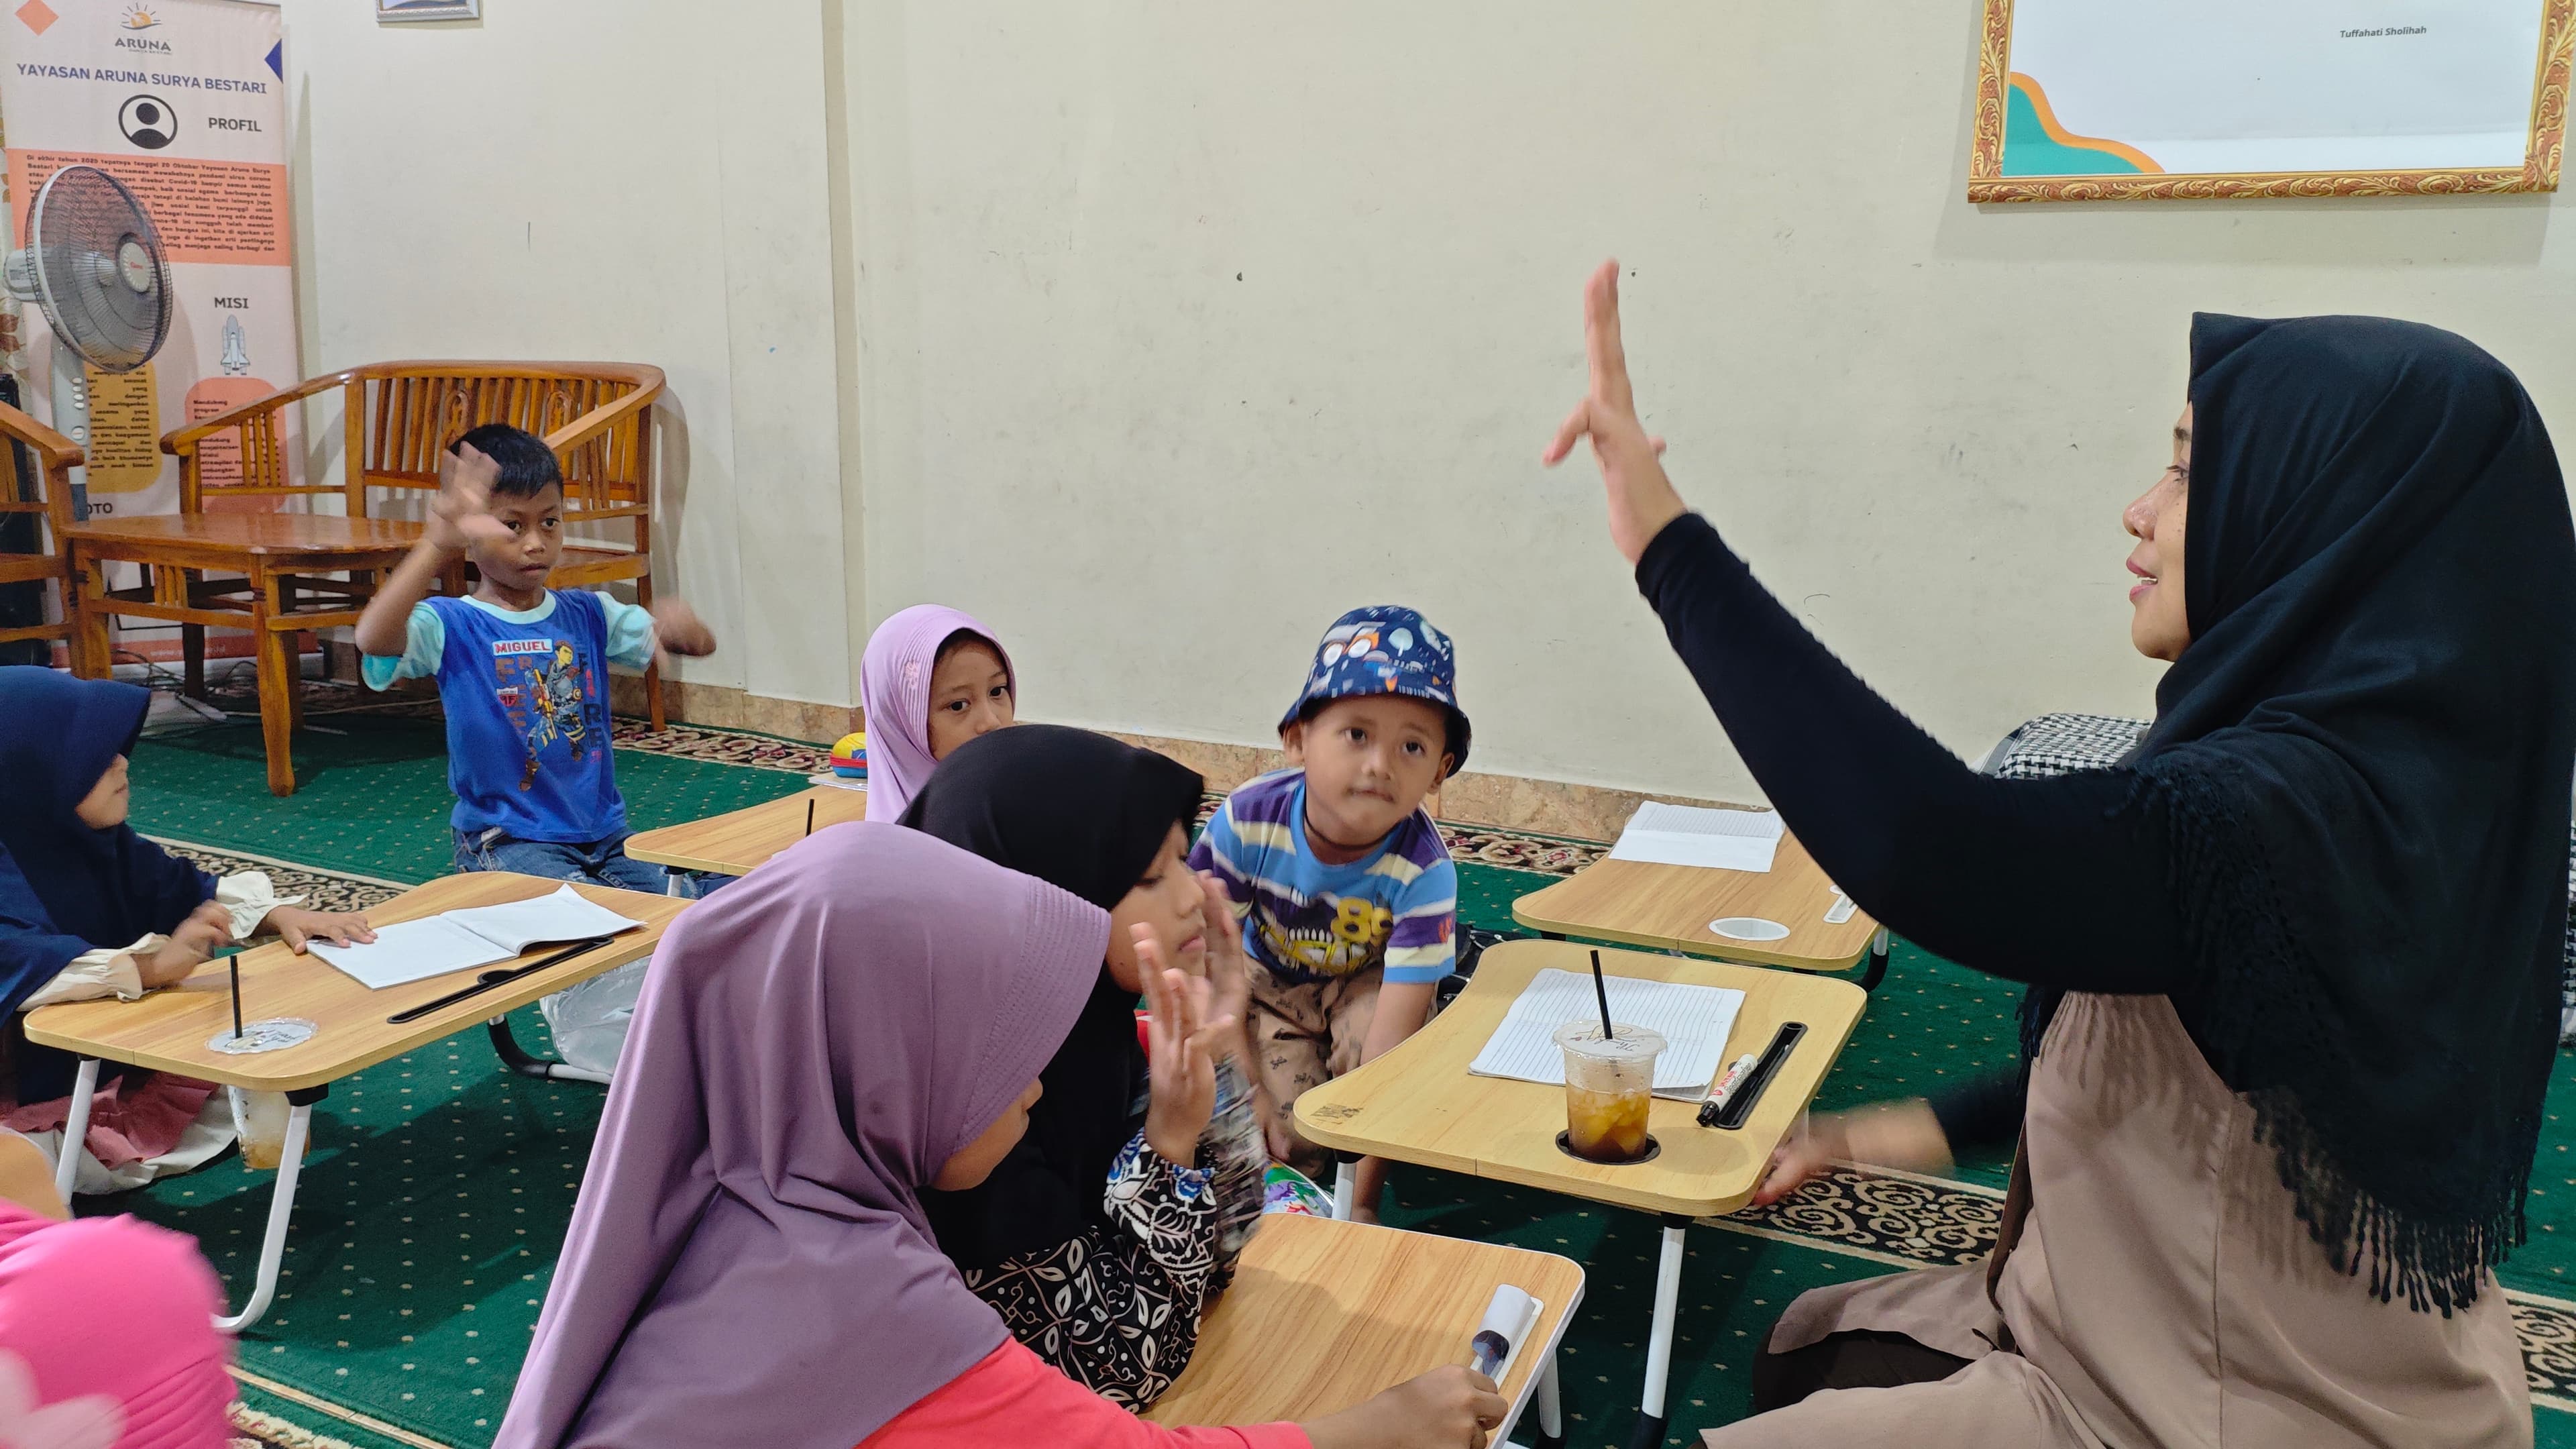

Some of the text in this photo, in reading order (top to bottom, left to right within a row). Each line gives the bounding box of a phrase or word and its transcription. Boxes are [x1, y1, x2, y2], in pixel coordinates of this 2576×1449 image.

[2340, 25, 2426, 38] Tuffahati Sholihah
[115, 37, 171, 51] ARUNA
[17, 63, 267, 94] YAYASAN ARUNA SURYA BESTARI
[209, 117, 262, 132] PROFIL
[215, 297, 249, 309] MISI
[495, 641, 550, 653] MIGUEL
